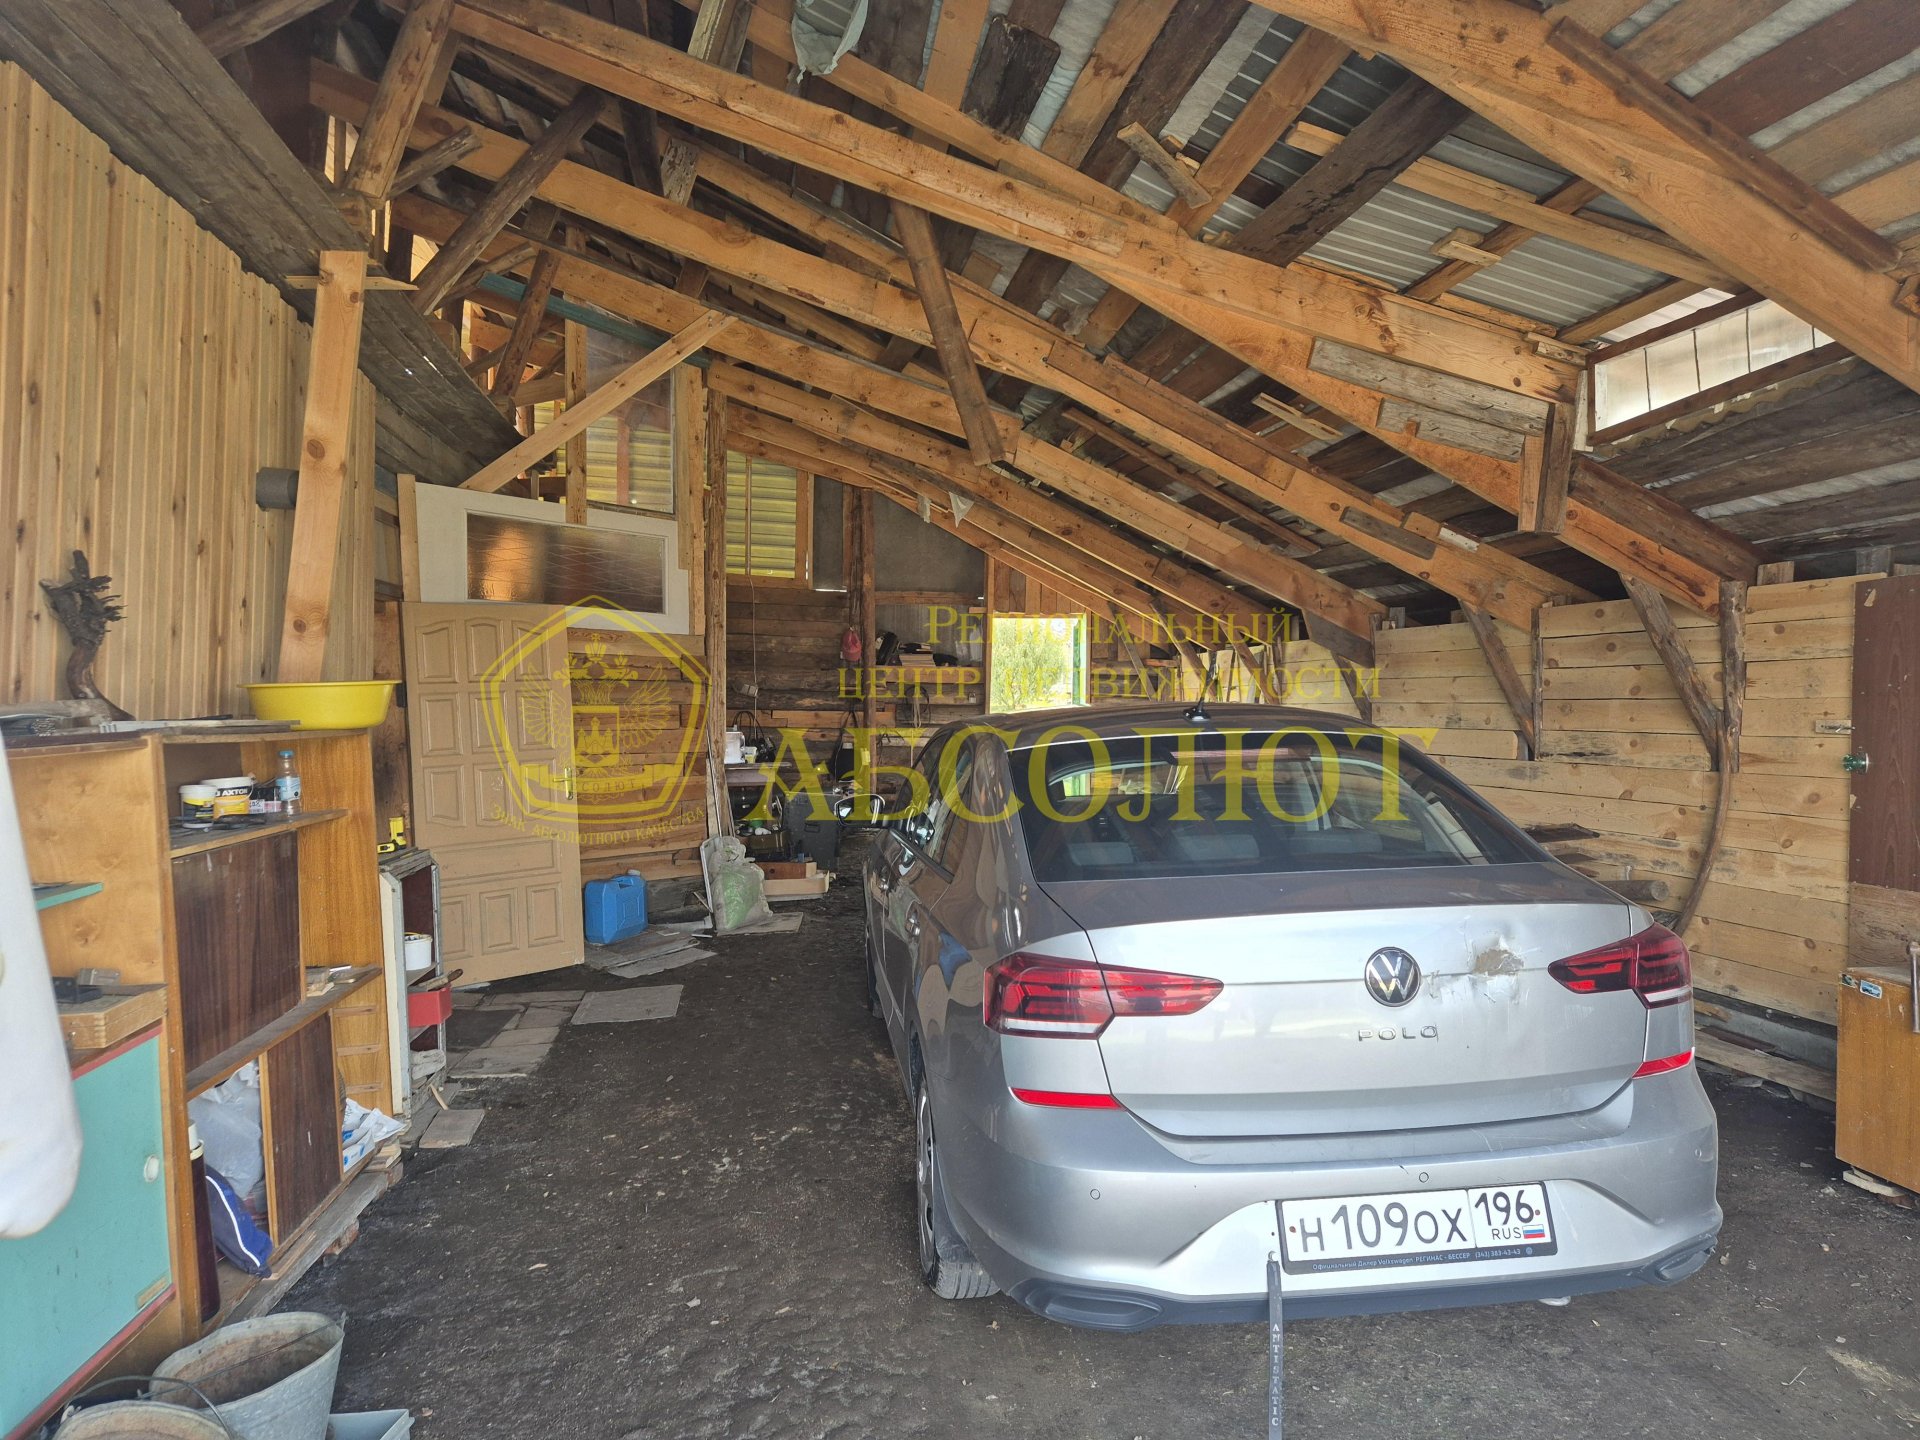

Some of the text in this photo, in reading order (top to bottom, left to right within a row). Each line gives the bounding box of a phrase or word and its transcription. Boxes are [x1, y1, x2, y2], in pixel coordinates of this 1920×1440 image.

[1358, 1025, 1437, 1042] POLO
[1474, 1189, 1535, 1227] 196
[1491, 1226, 1522, 1241] RUS
[1271, 1324, 1280, 1425] ANTISTATIC
